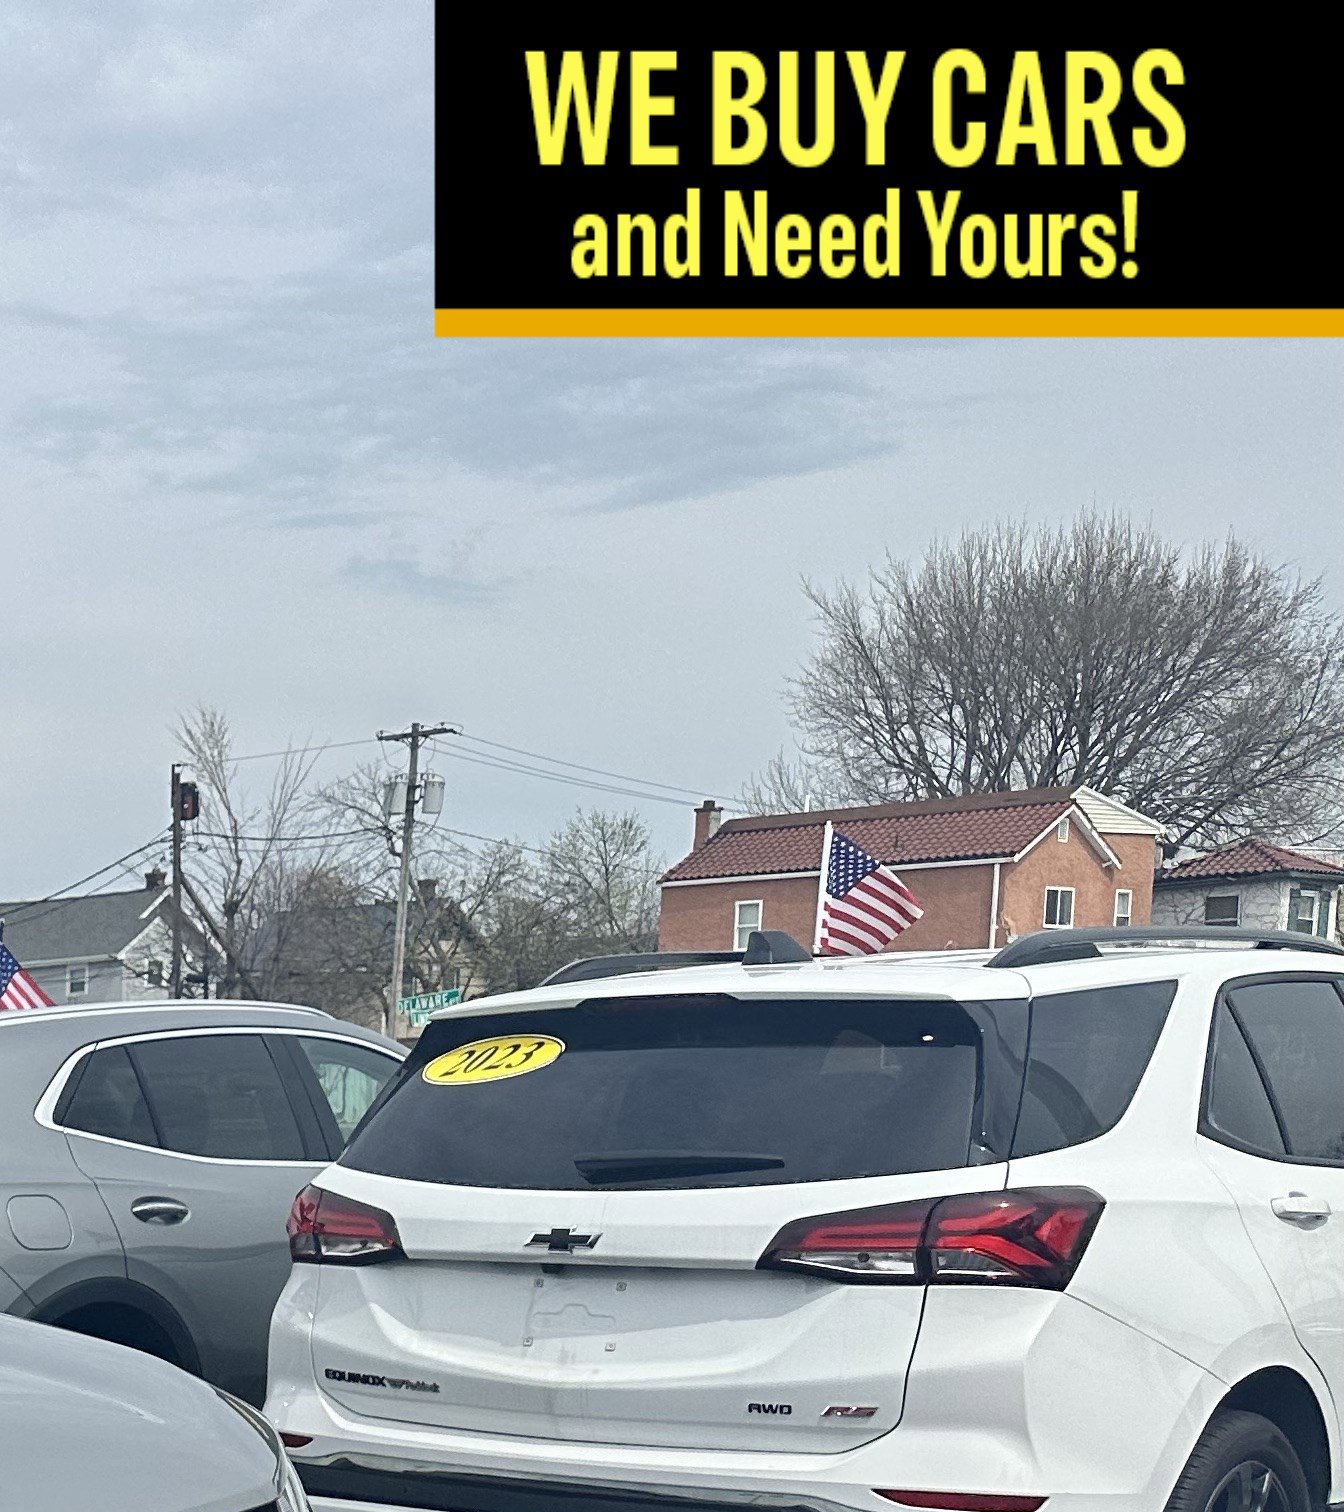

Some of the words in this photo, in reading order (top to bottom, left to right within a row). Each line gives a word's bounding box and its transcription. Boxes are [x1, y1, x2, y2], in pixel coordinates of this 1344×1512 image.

[397, 993, 449, 1014] DELAWARE
[439, 1041, 545, 1077] 2023
[324, 1368, 387, 1388] EQUINOX
[748, 1403, 792, 1415] AWD
